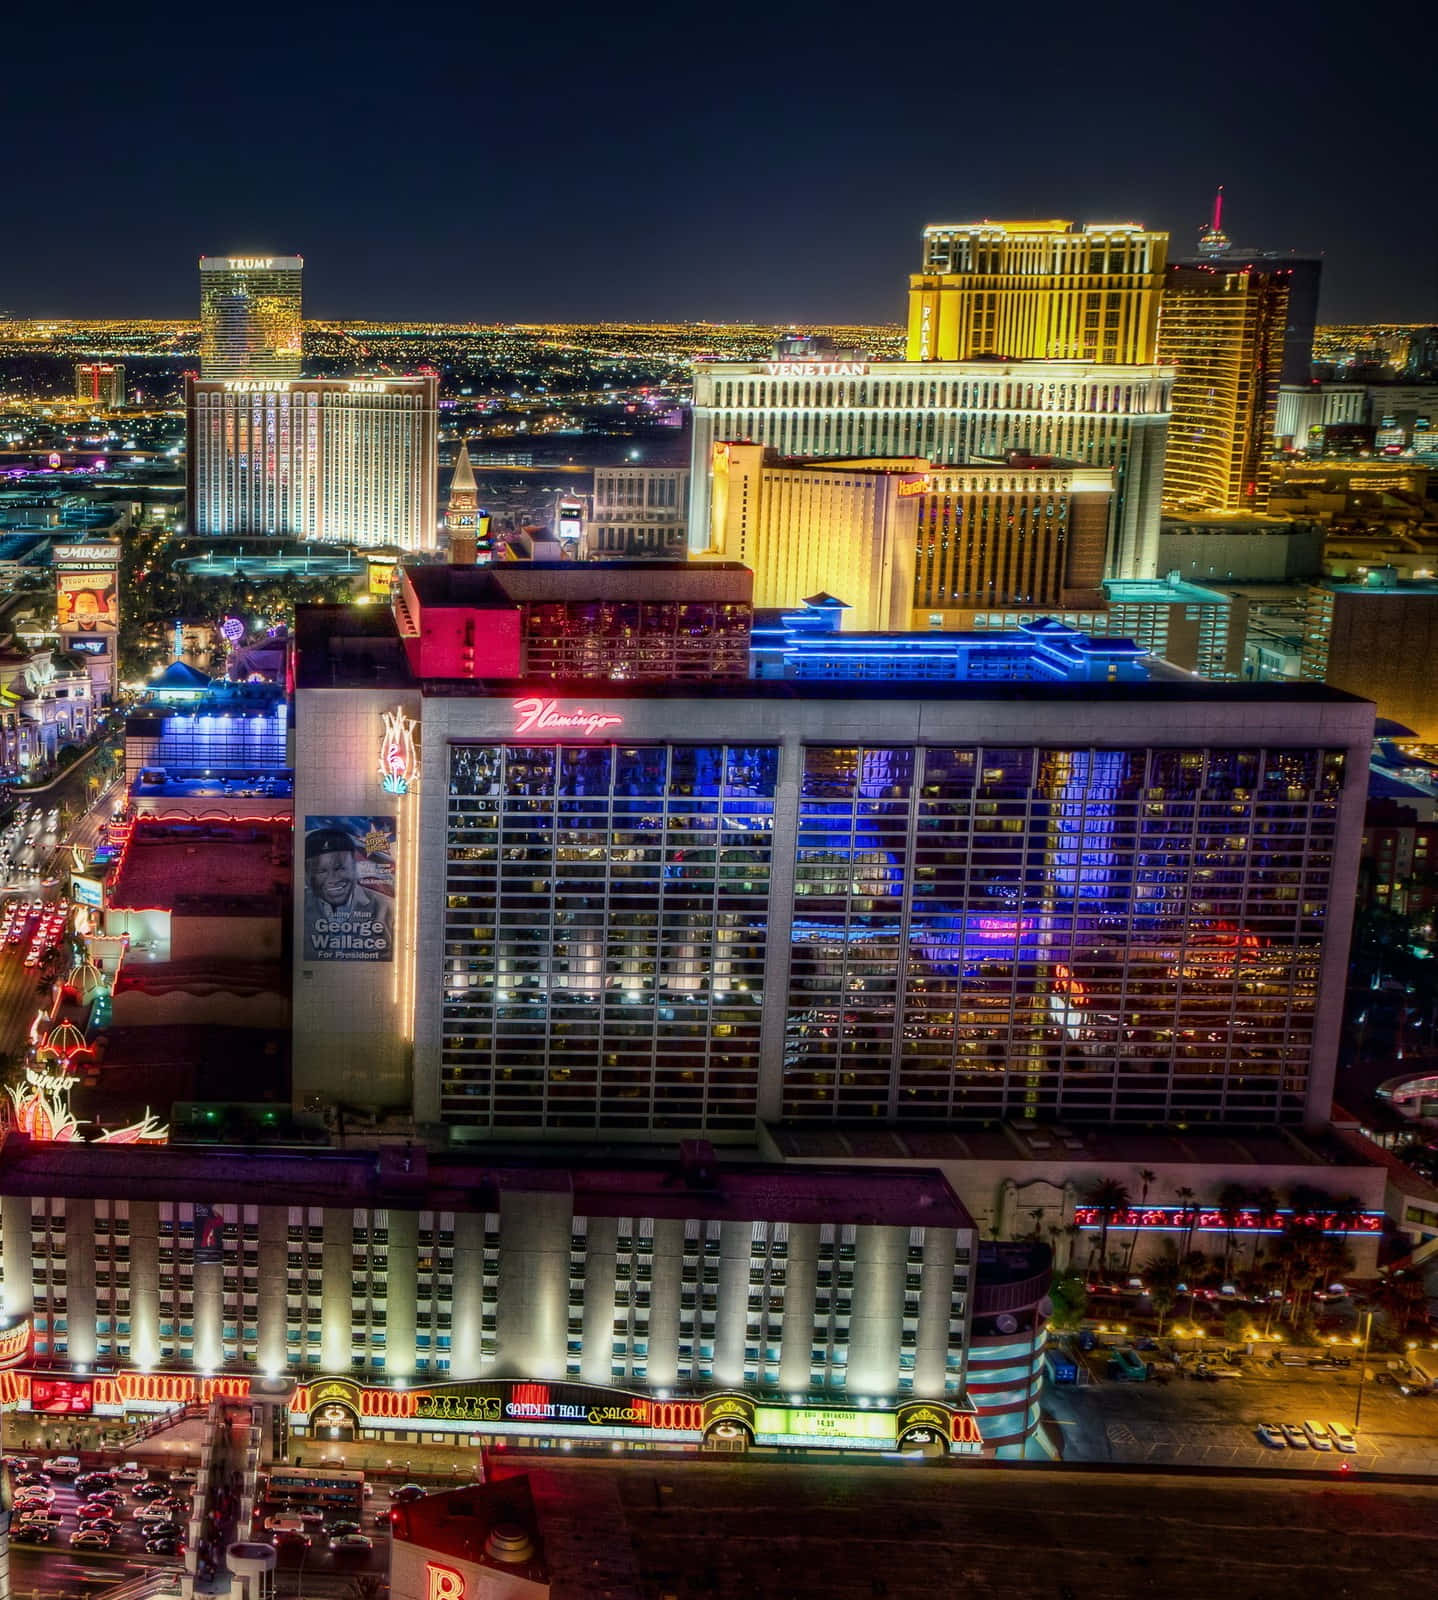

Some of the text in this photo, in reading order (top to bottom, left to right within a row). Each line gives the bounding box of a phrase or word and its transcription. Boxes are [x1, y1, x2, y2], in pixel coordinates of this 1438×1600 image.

[227, 258, 273, 269] TRUMP
[921, 306, 932, 361] PALA
[768, 362, 865, 376] VENETIAN
[224, 381, 387, 393] TREASURE ISLAND
[512, 698, 623, 735] Flamingo
[314, 918, 384, 936] George
[312, 934, 387, 949] Wallace
[318, 951, 379, 960] For President
[415, 1394, 501, 1420] BILL'S
[560, 1404, 587, 1418] HALL
[587, 1407, 603, 1424] &
[601, 1407, 648, 1421] SALOON
